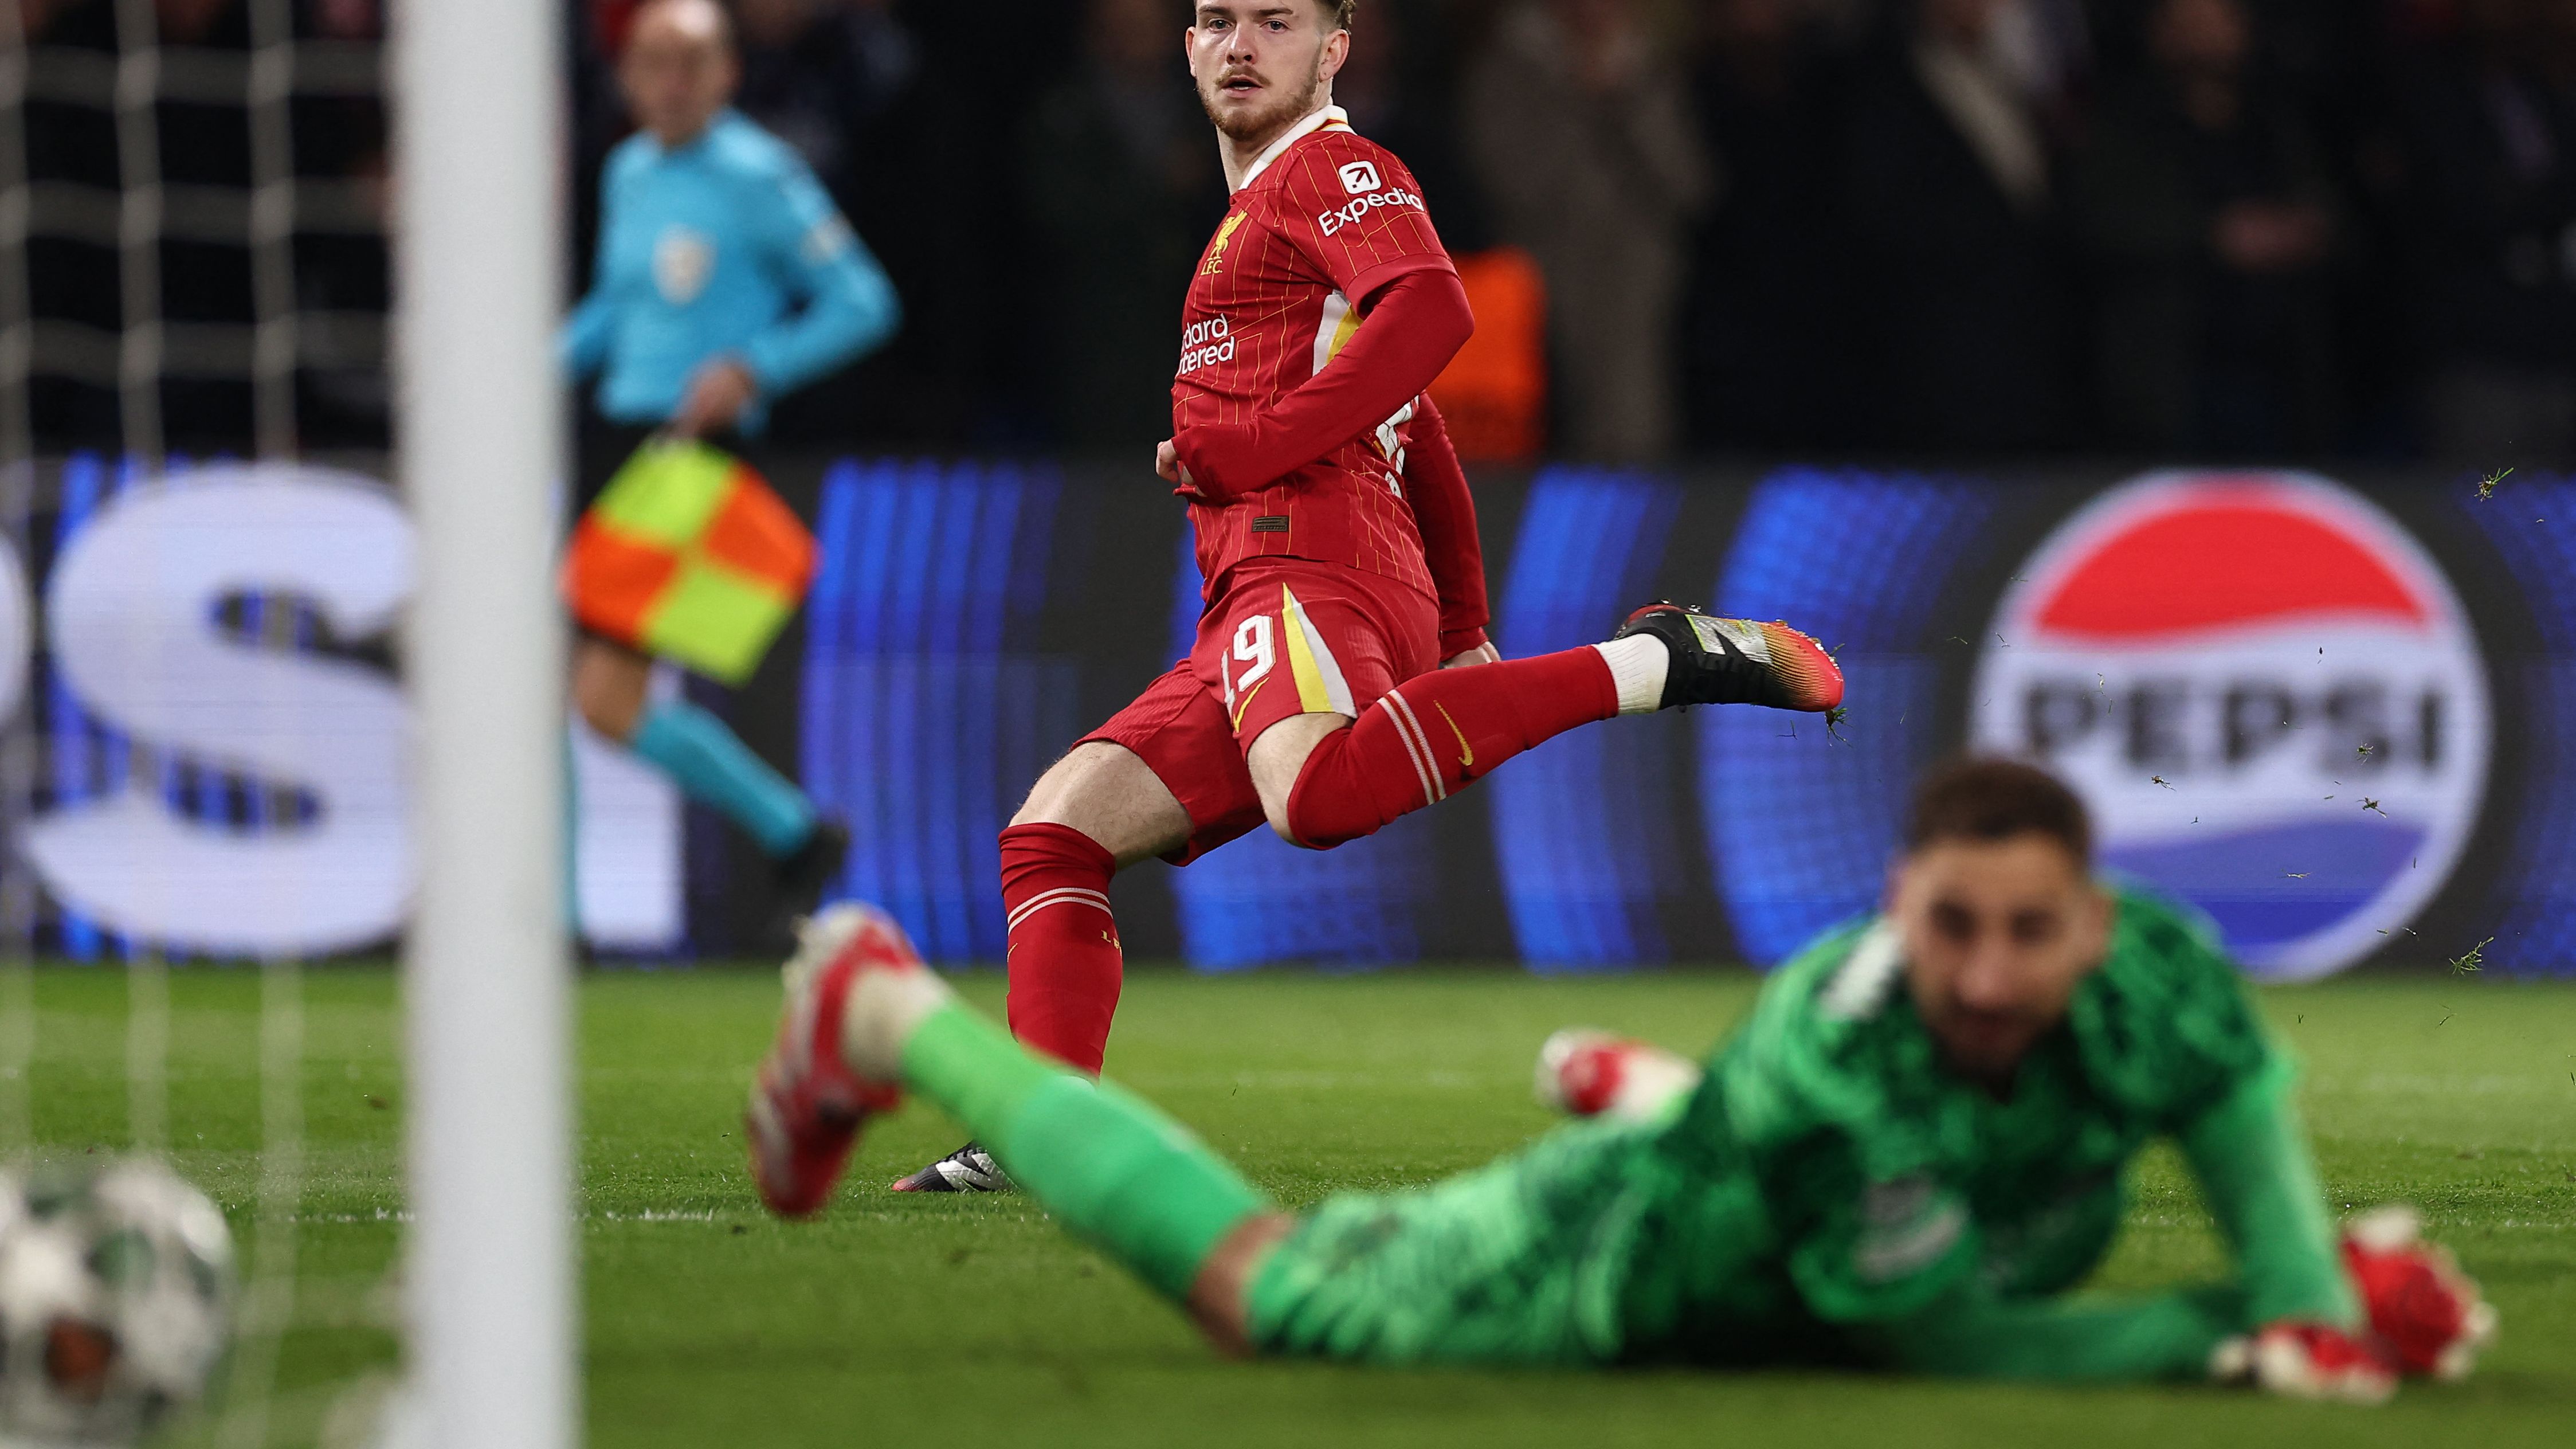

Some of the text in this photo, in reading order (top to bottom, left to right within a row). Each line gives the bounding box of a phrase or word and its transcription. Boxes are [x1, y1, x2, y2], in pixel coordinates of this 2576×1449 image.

[1318, 187, 1425, 237] Expedia
[1178, 336, 1235, 374] tered
[1181, 313, 1228, 355] dard
[2020, 676, 2445, 777] PEPSI
